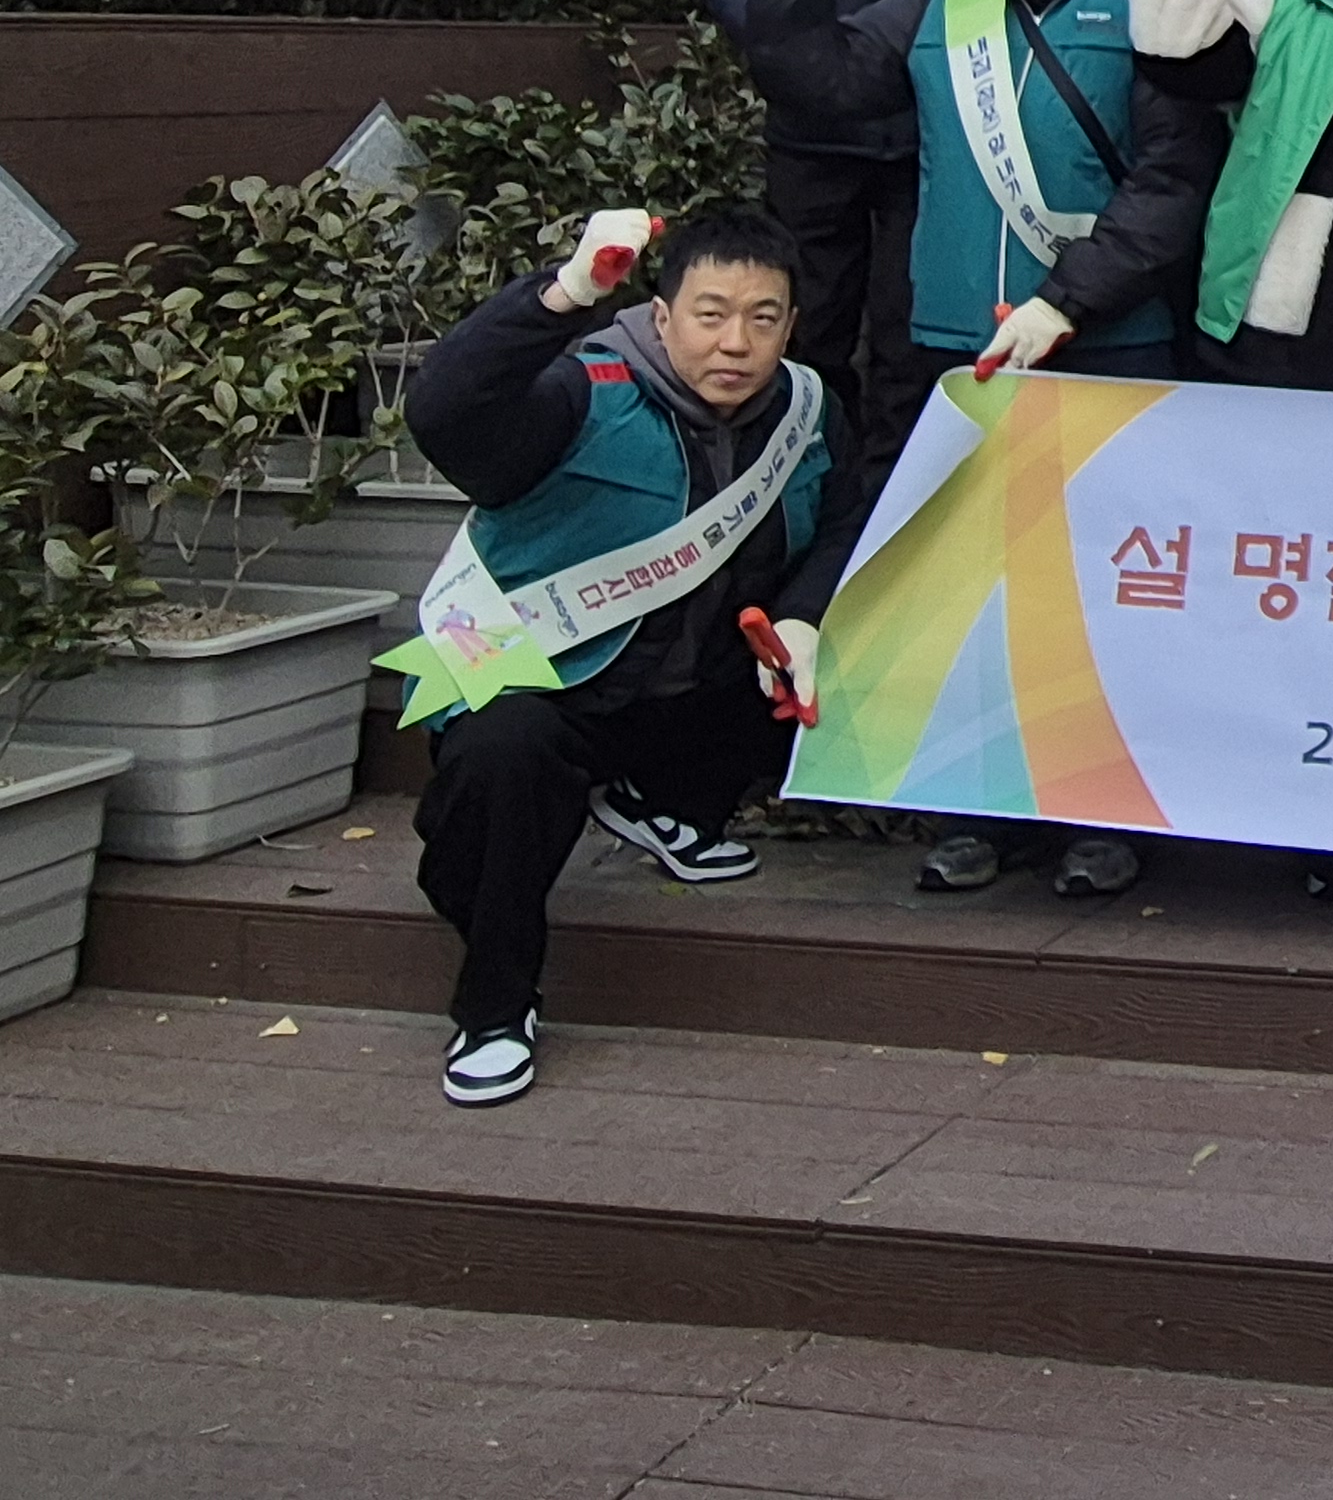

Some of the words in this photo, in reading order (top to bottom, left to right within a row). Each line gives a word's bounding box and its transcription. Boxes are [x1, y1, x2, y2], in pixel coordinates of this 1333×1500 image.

[987, 132, 1007, 156] 앞
[576, 542, 702, 610] 동참합시다
[1110, 525, 1192, 610] 설
